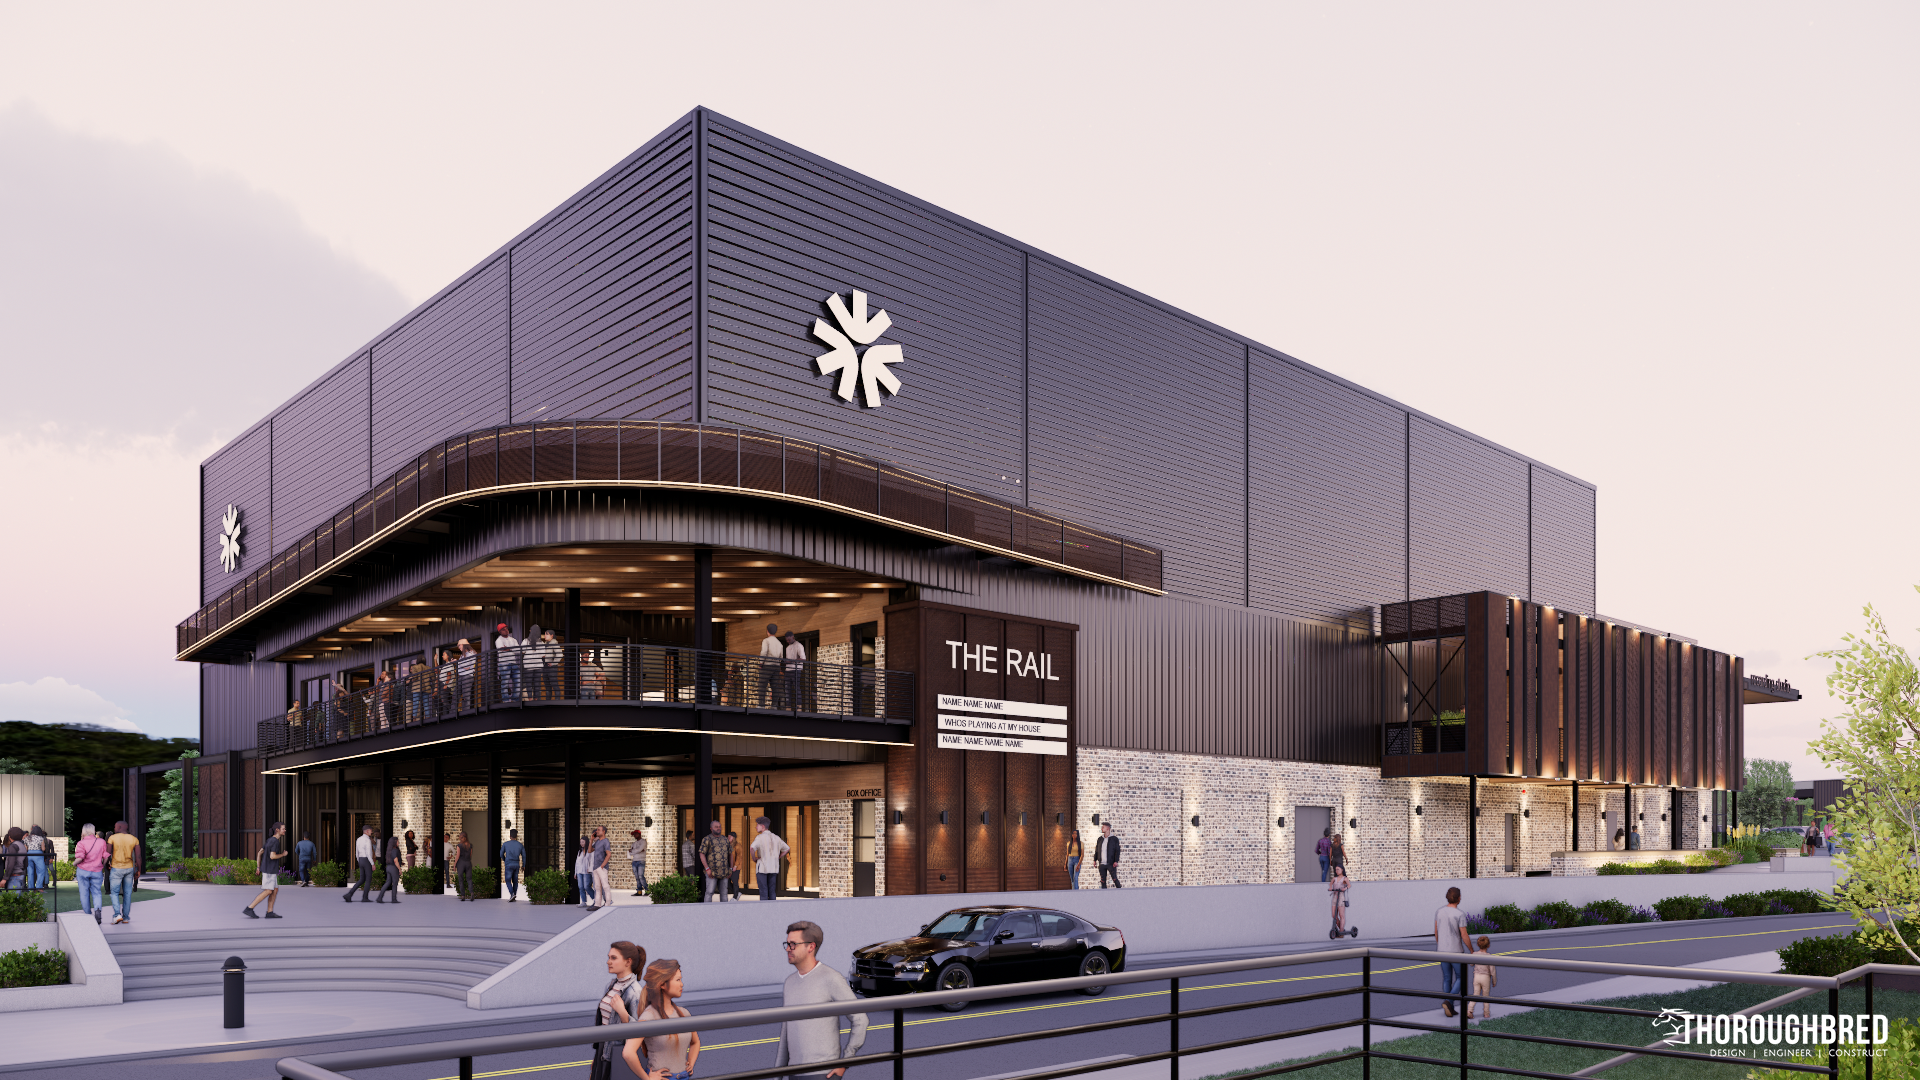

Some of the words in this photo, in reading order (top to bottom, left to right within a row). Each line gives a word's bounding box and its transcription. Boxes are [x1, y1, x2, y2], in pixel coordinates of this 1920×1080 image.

[946, 640, 997, 673] THE
[1006, 648, 1059, 680] RAIL
[942, 697, 962, 706] NAME
[964, 699, 983, 708] NAME
[984, 702, 1004, 710] NAME
[944, 718, 966, 728] WHOS
[968, 720, 996, 730] PLAYING
[1019, 724, 1041, 733] HOUSE
[942, 736, 962, 744] NAME
[964, 737, 983, 745] NAME
[985, 738, 1003, 747] NAME
[1005, 740, 1023, 748] NAME
[712, 776, 738, 795] THE
[744, 775, 774, 794] RAIL
[847, 789, 859, 797] BOX
[860, 788, 882, 797] OFFICE
